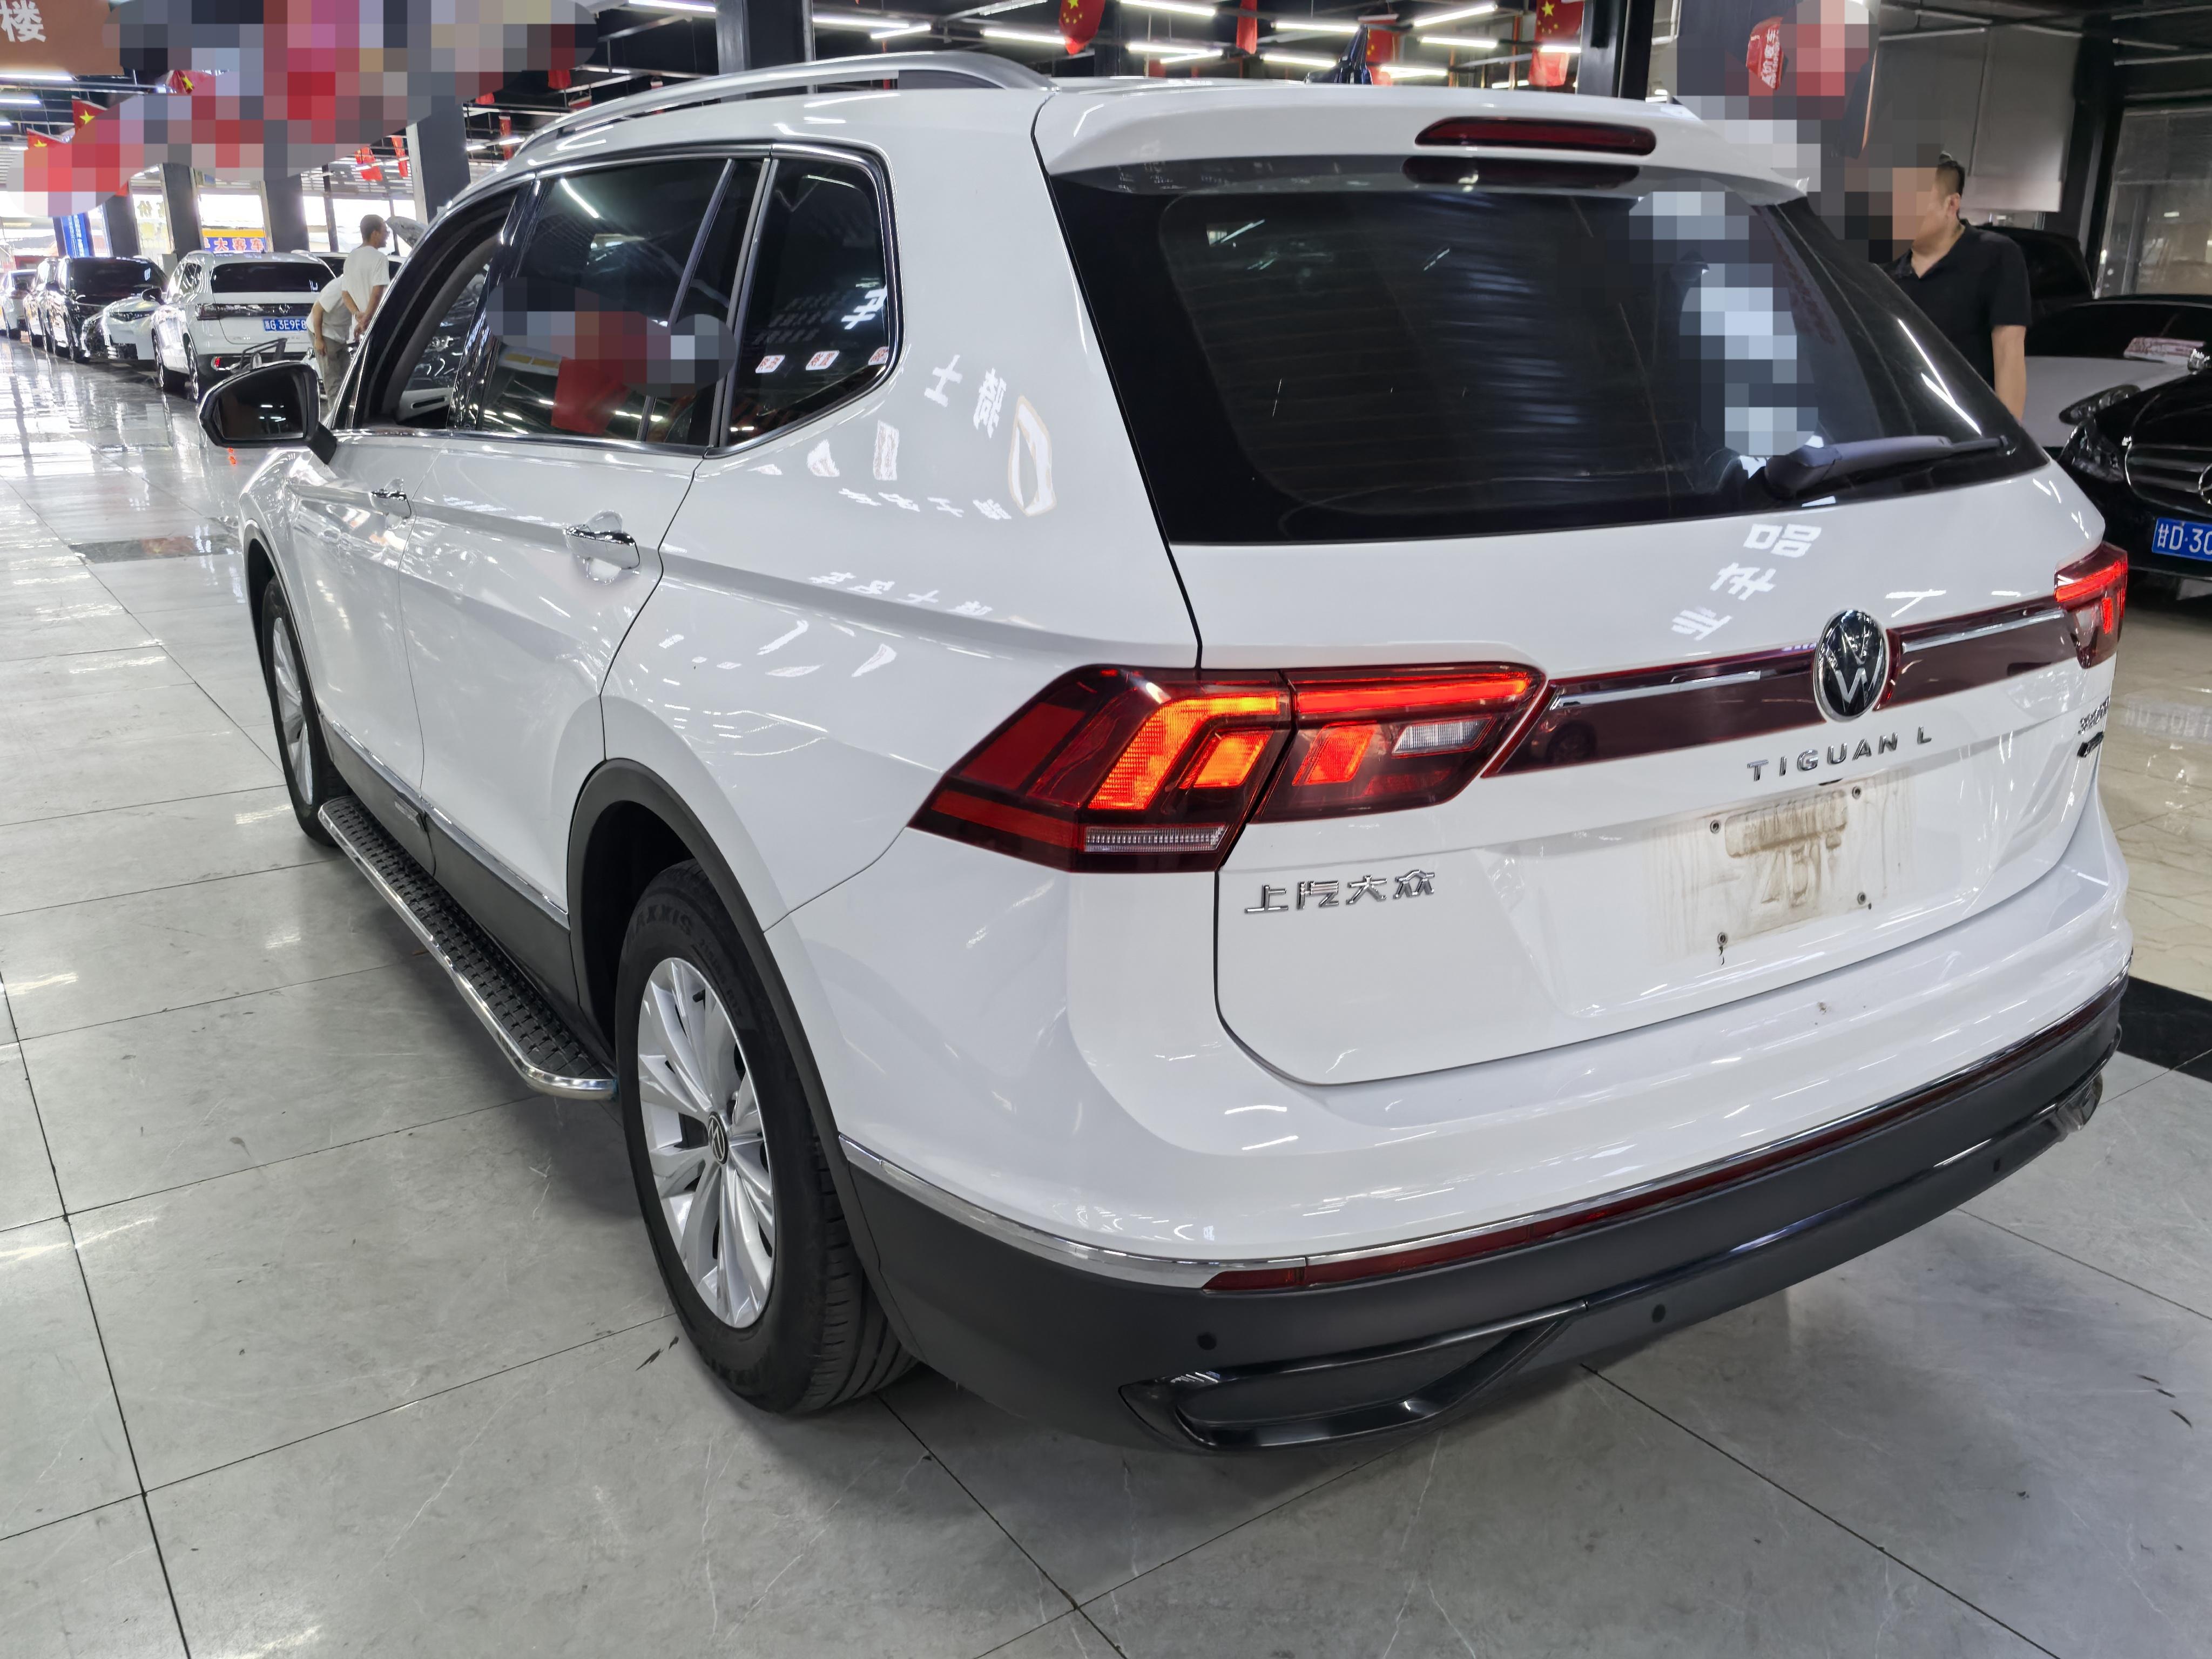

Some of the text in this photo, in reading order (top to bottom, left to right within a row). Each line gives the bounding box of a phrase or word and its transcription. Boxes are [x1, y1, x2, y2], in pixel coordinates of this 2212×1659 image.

[1747, 726, 1932, 782] TIGUAN L
[1244, 869, 1435, 913] 上汽大众
